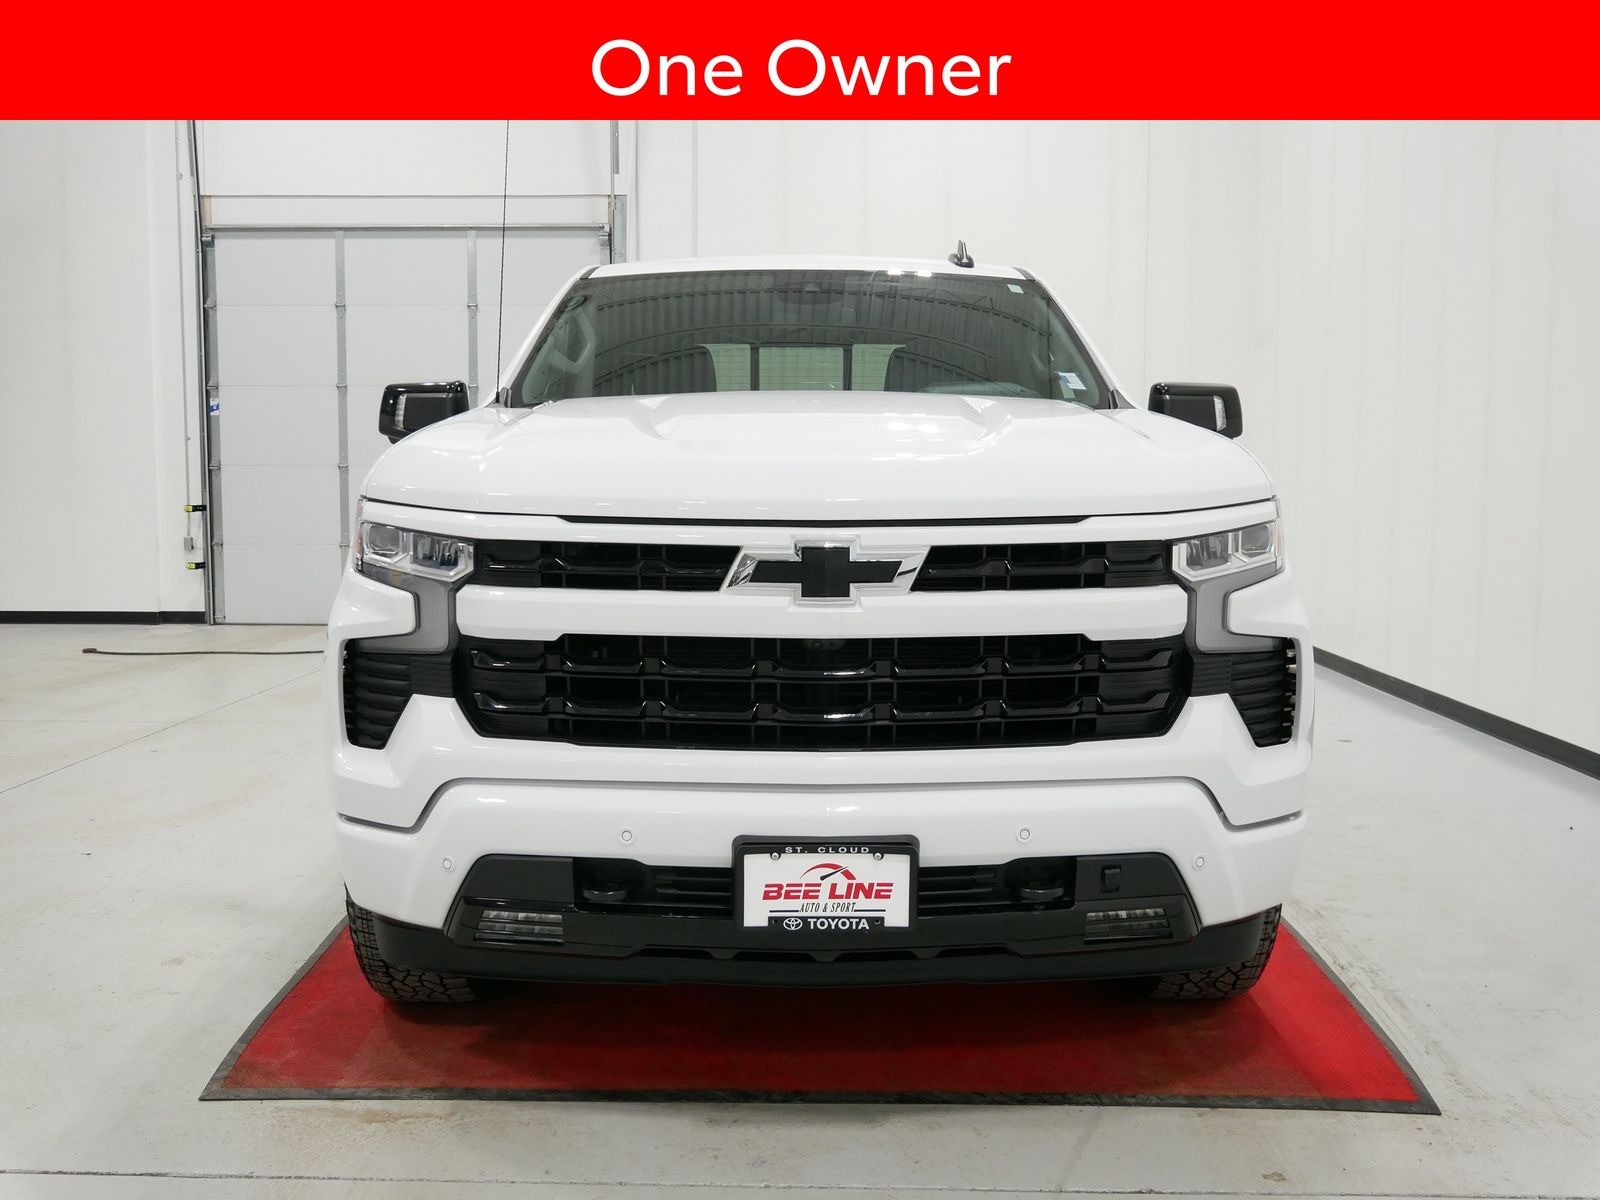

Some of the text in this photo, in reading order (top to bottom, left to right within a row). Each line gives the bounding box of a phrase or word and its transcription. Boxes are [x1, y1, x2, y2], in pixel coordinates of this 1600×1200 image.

[785, 846, 870, 854] ST. CLOUD
[762, 882, 894, 900] BEE LINE
[800, 902, 856, 912] AUTO & SPORT
[807, 918, 870, 930] TOYOTA
